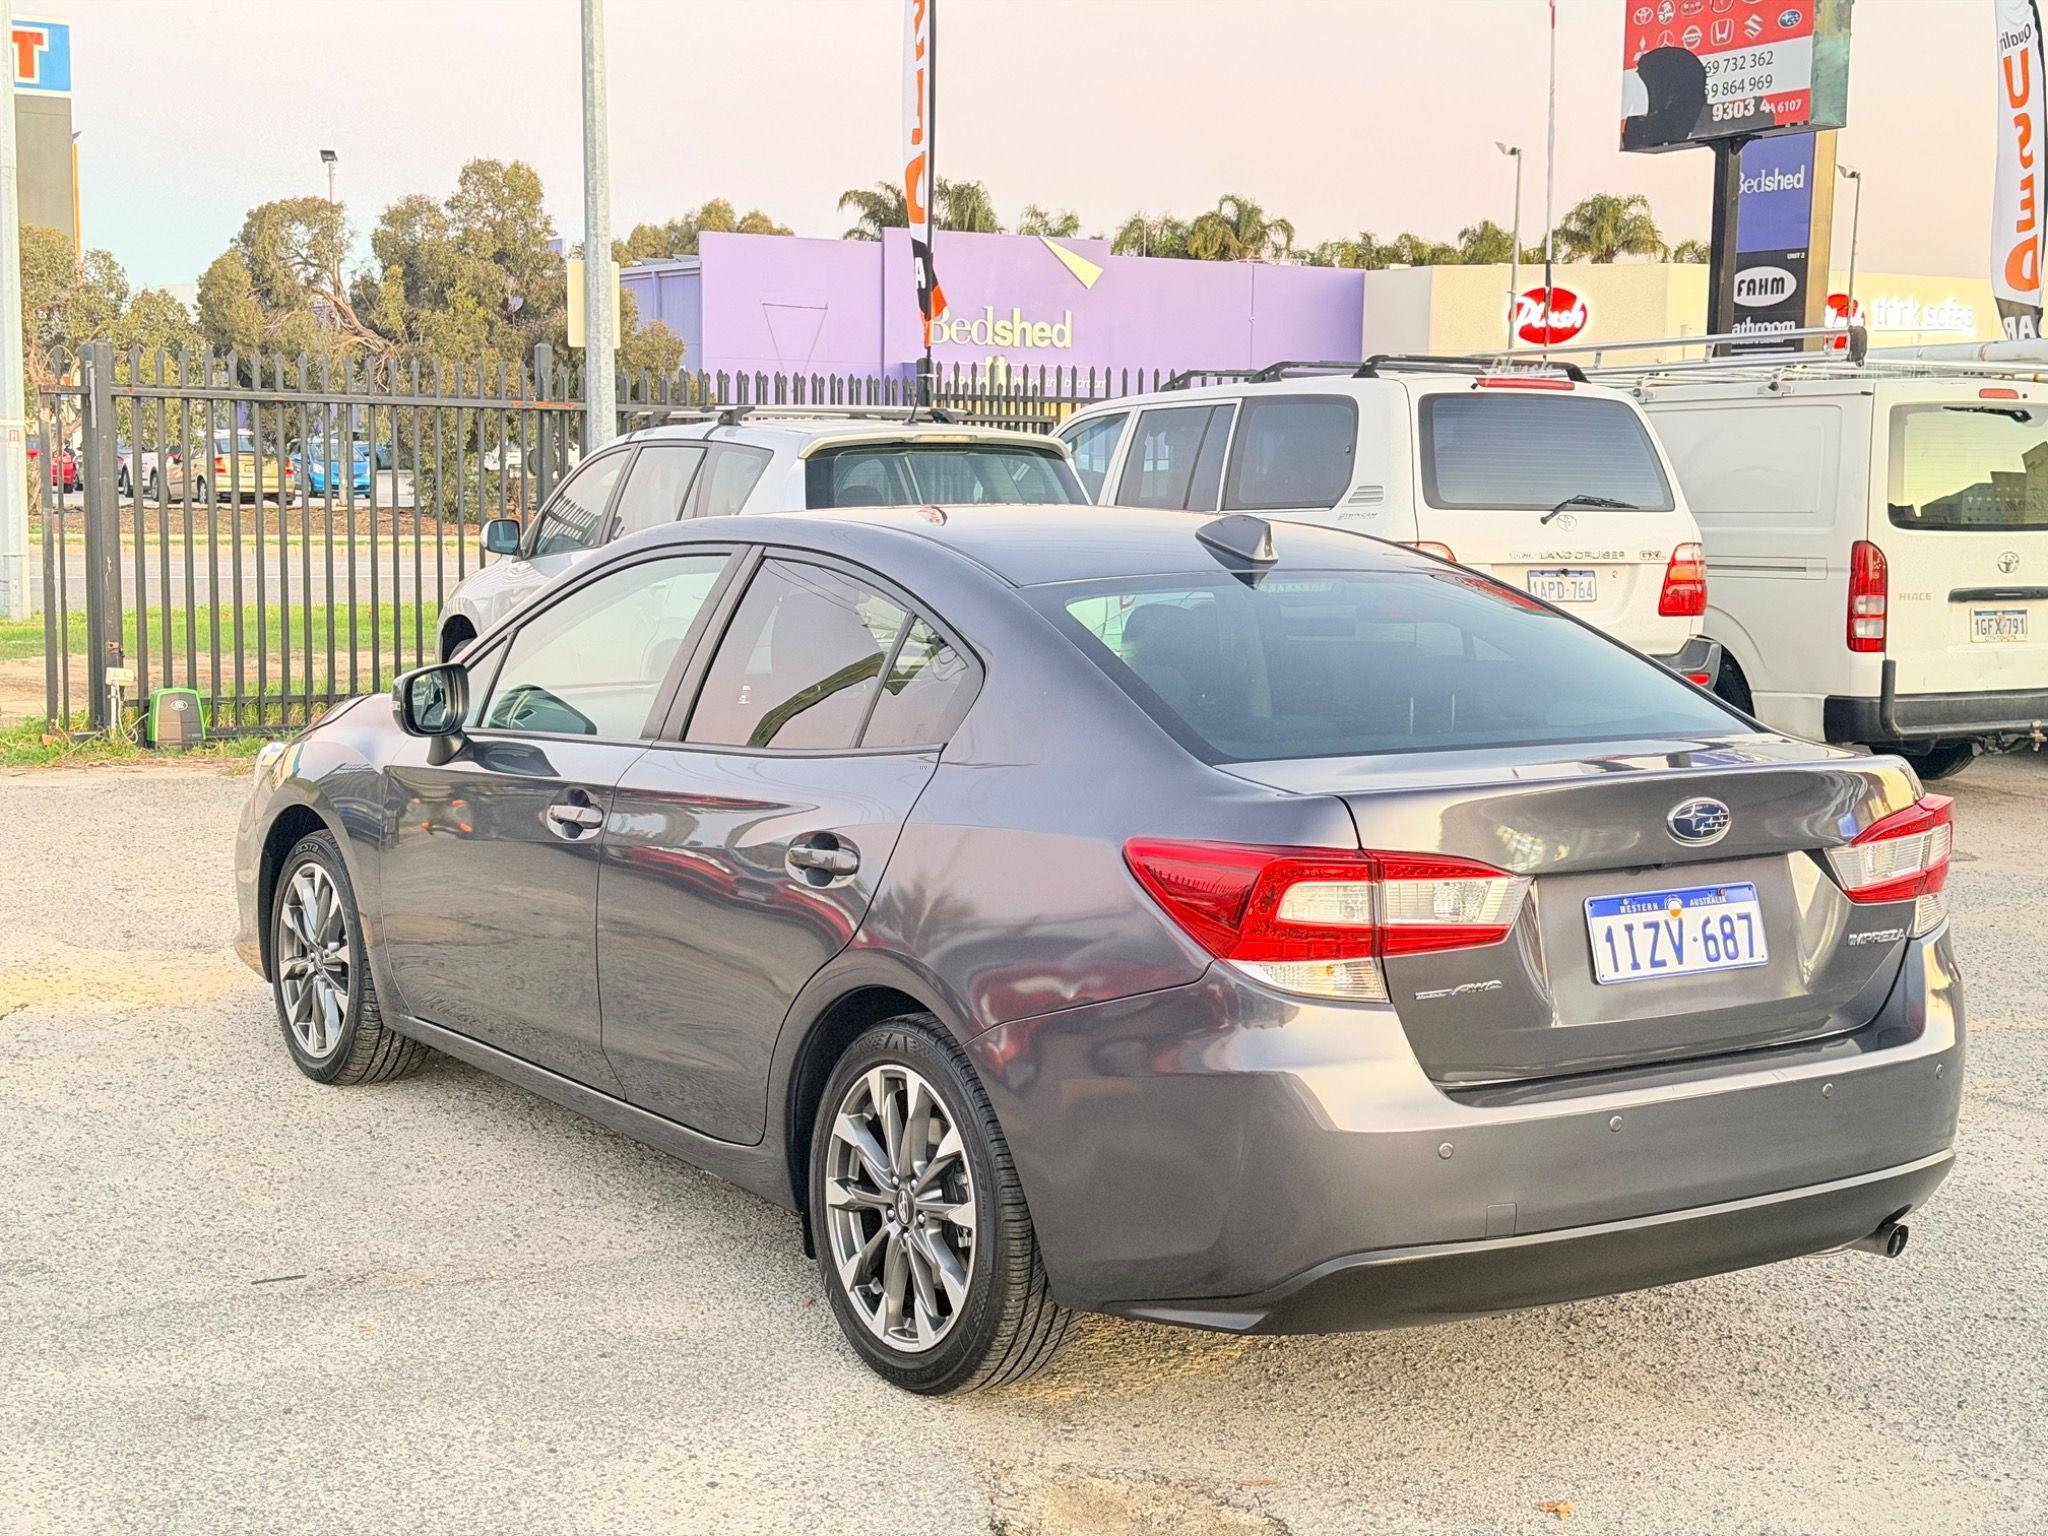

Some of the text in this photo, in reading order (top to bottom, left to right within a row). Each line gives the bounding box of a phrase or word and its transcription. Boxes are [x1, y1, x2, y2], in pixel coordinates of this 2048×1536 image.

[1723, 56, 1746, 71] 732
[1750, 50, 1774, 67] 362
[1721, 79, 1745, 97] 864
[1749, 74, 1773, 92] 969
[1712, 98, 1755, 122] 9303
[1777, 98, 1802, 113] 6107
[1736, 276, 1785, 297] FAHM
[929, 306, 1072, 348] Bedshed
[1899, 592, 1932, 601] HIACE
[1619, 894, 1727, 914] WESTERN AUSTRALIA
[1848, 928, 1905, 946] IMPREZA
